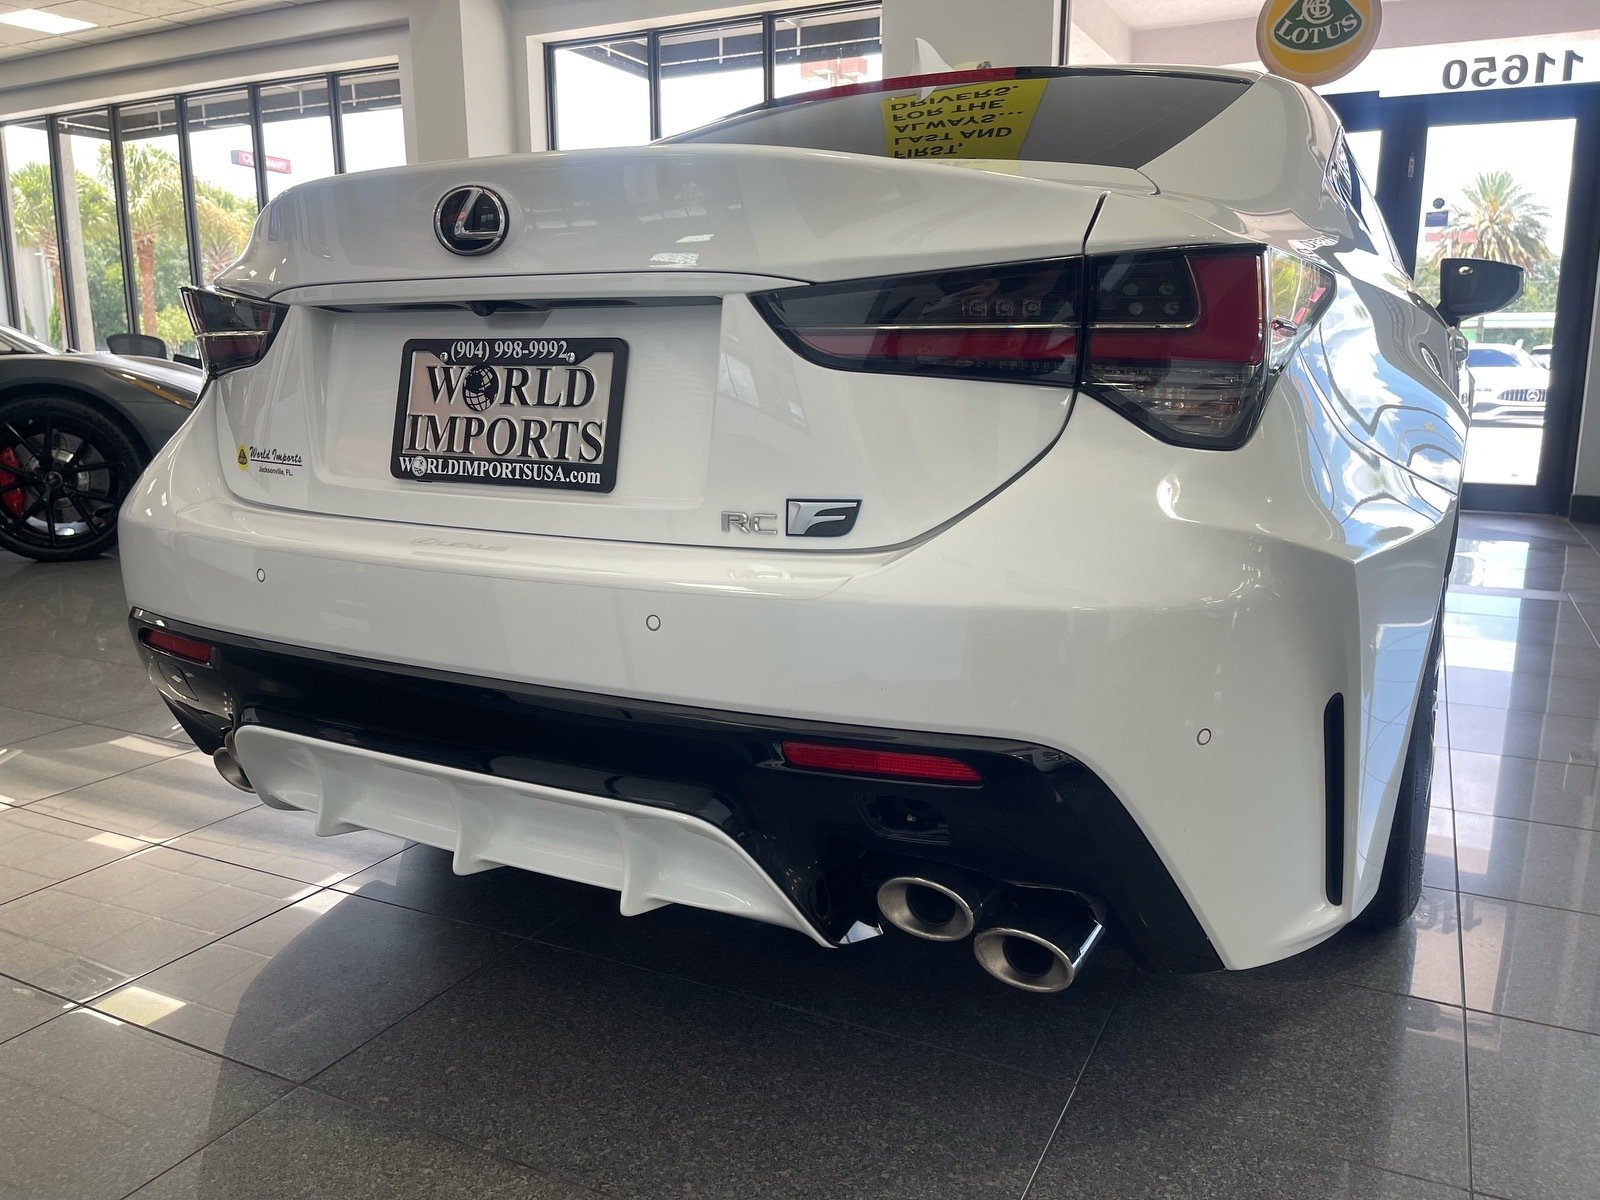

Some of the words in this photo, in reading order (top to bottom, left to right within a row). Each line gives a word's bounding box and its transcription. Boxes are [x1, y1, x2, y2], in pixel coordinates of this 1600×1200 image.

[1276, 13, 1358, 44] LOTUS
[451, 340, 490, 362] (904)
[494, 340, 568, 359] 998-9992
[426, 364, 595, 412] WORLD
[404, 414, 603, 463] IMPORTS
[250, 446, 271, 460] World
[272, 449, 302, 463] Imports
[259, 466, 285, 476] Jacksonville,
[398, 456, 601, 484] WORLDIMPORTSUSA.com
[721, 510, 778, 535] RC
